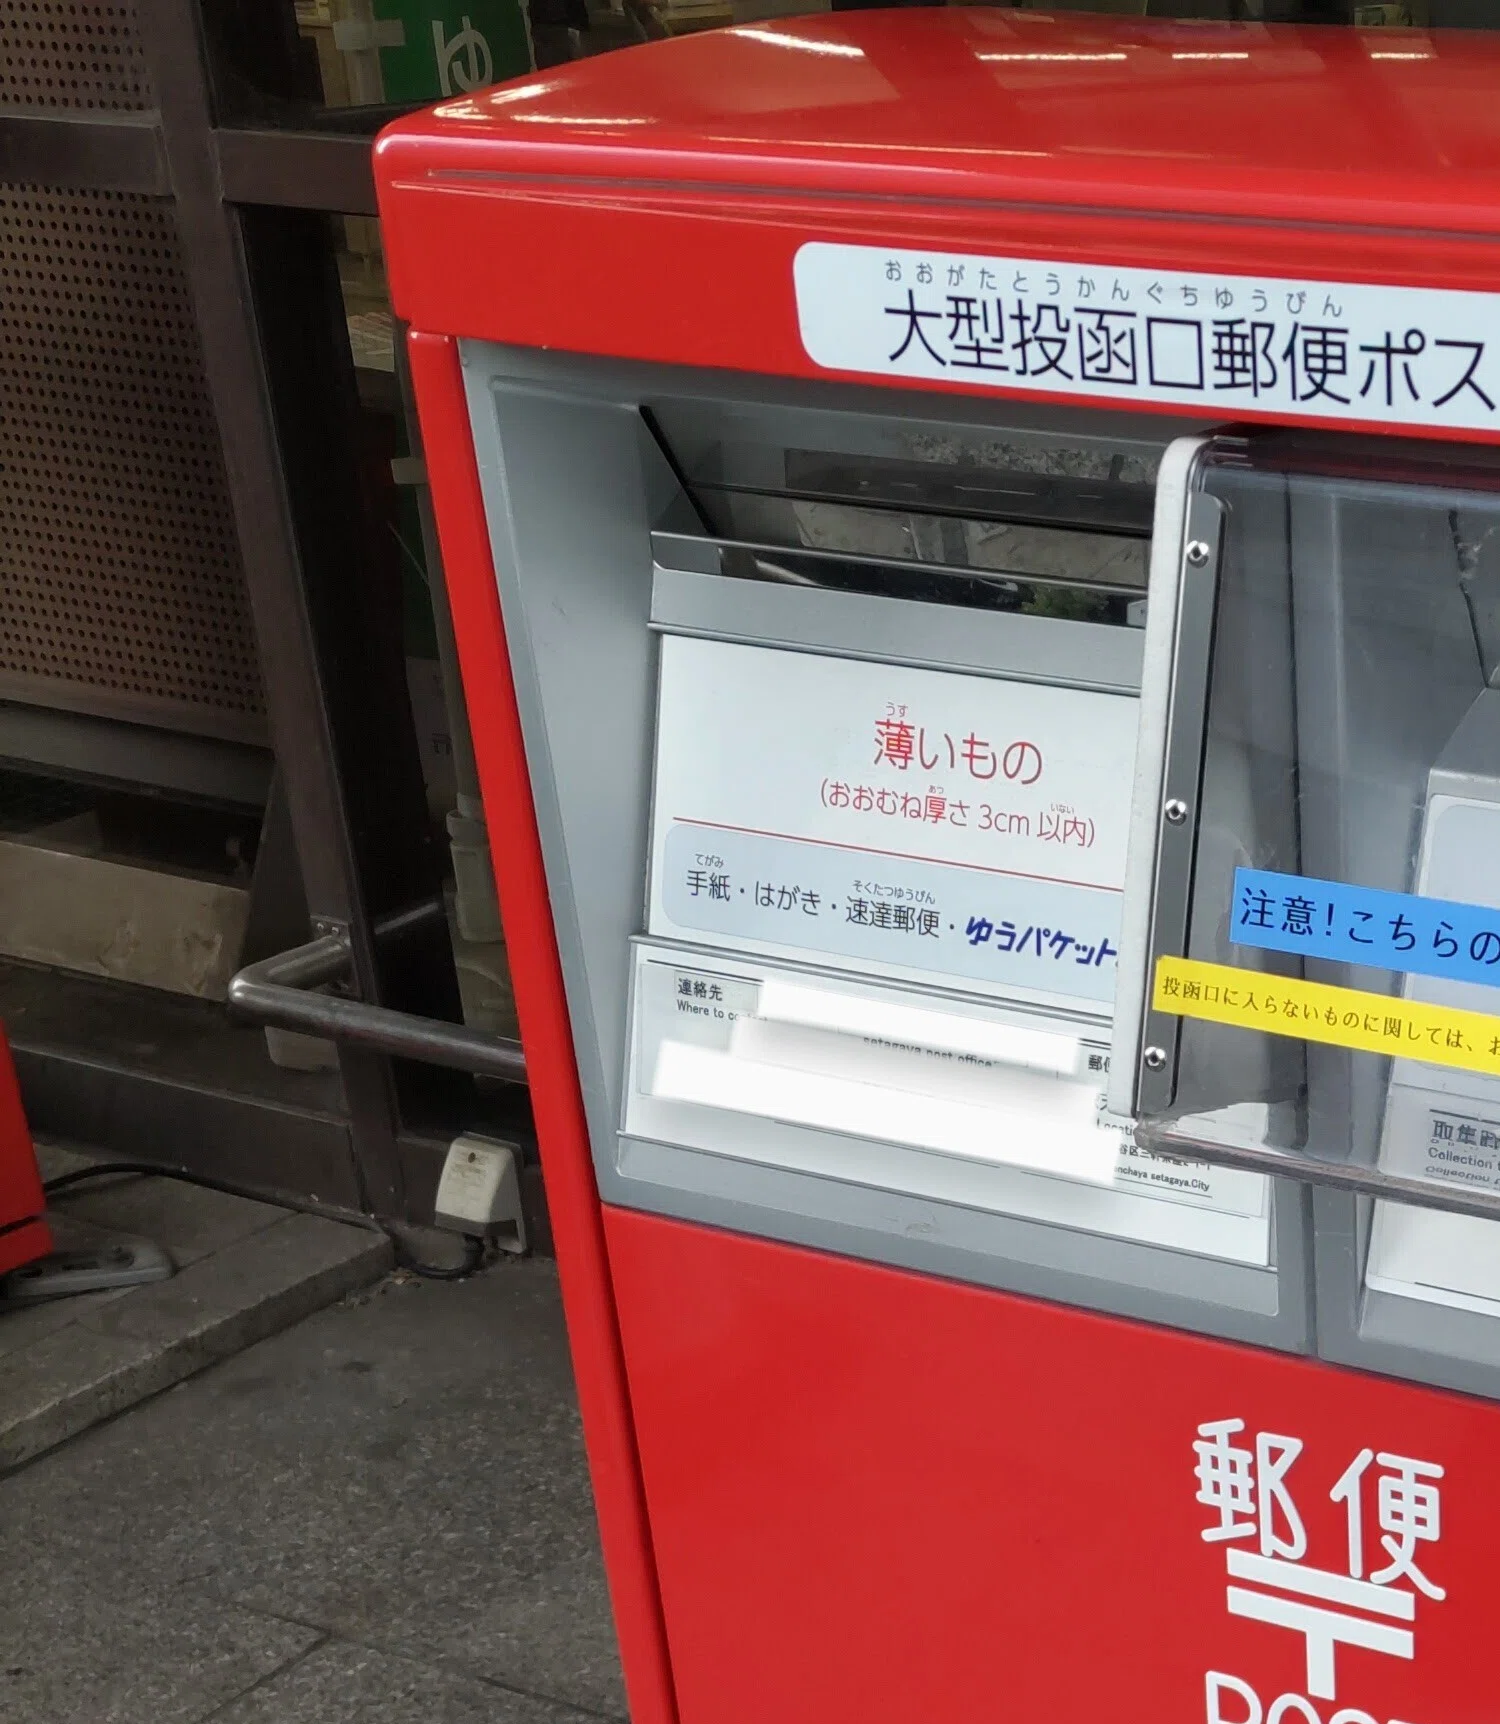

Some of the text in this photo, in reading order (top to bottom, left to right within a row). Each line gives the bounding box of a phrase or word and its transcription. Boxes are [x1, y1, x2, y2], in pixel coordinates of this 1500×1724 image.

[431, 15, 493, 97] ゆ
[884, 257, 1344, 318] おおがたとうかんぐちゆうびん
[886, 702, 909, 718] うす
[873, 718, 1043, 786] 薄いもの
[676, 999, 709, 1017] Where
[713, 1007, 724, 1019] to
[677, 977, 723, 1002] 連絡先
[1427, 1147, 1494, 1170] Collection
[1191, 1417, 1447, 1601] 郵便
